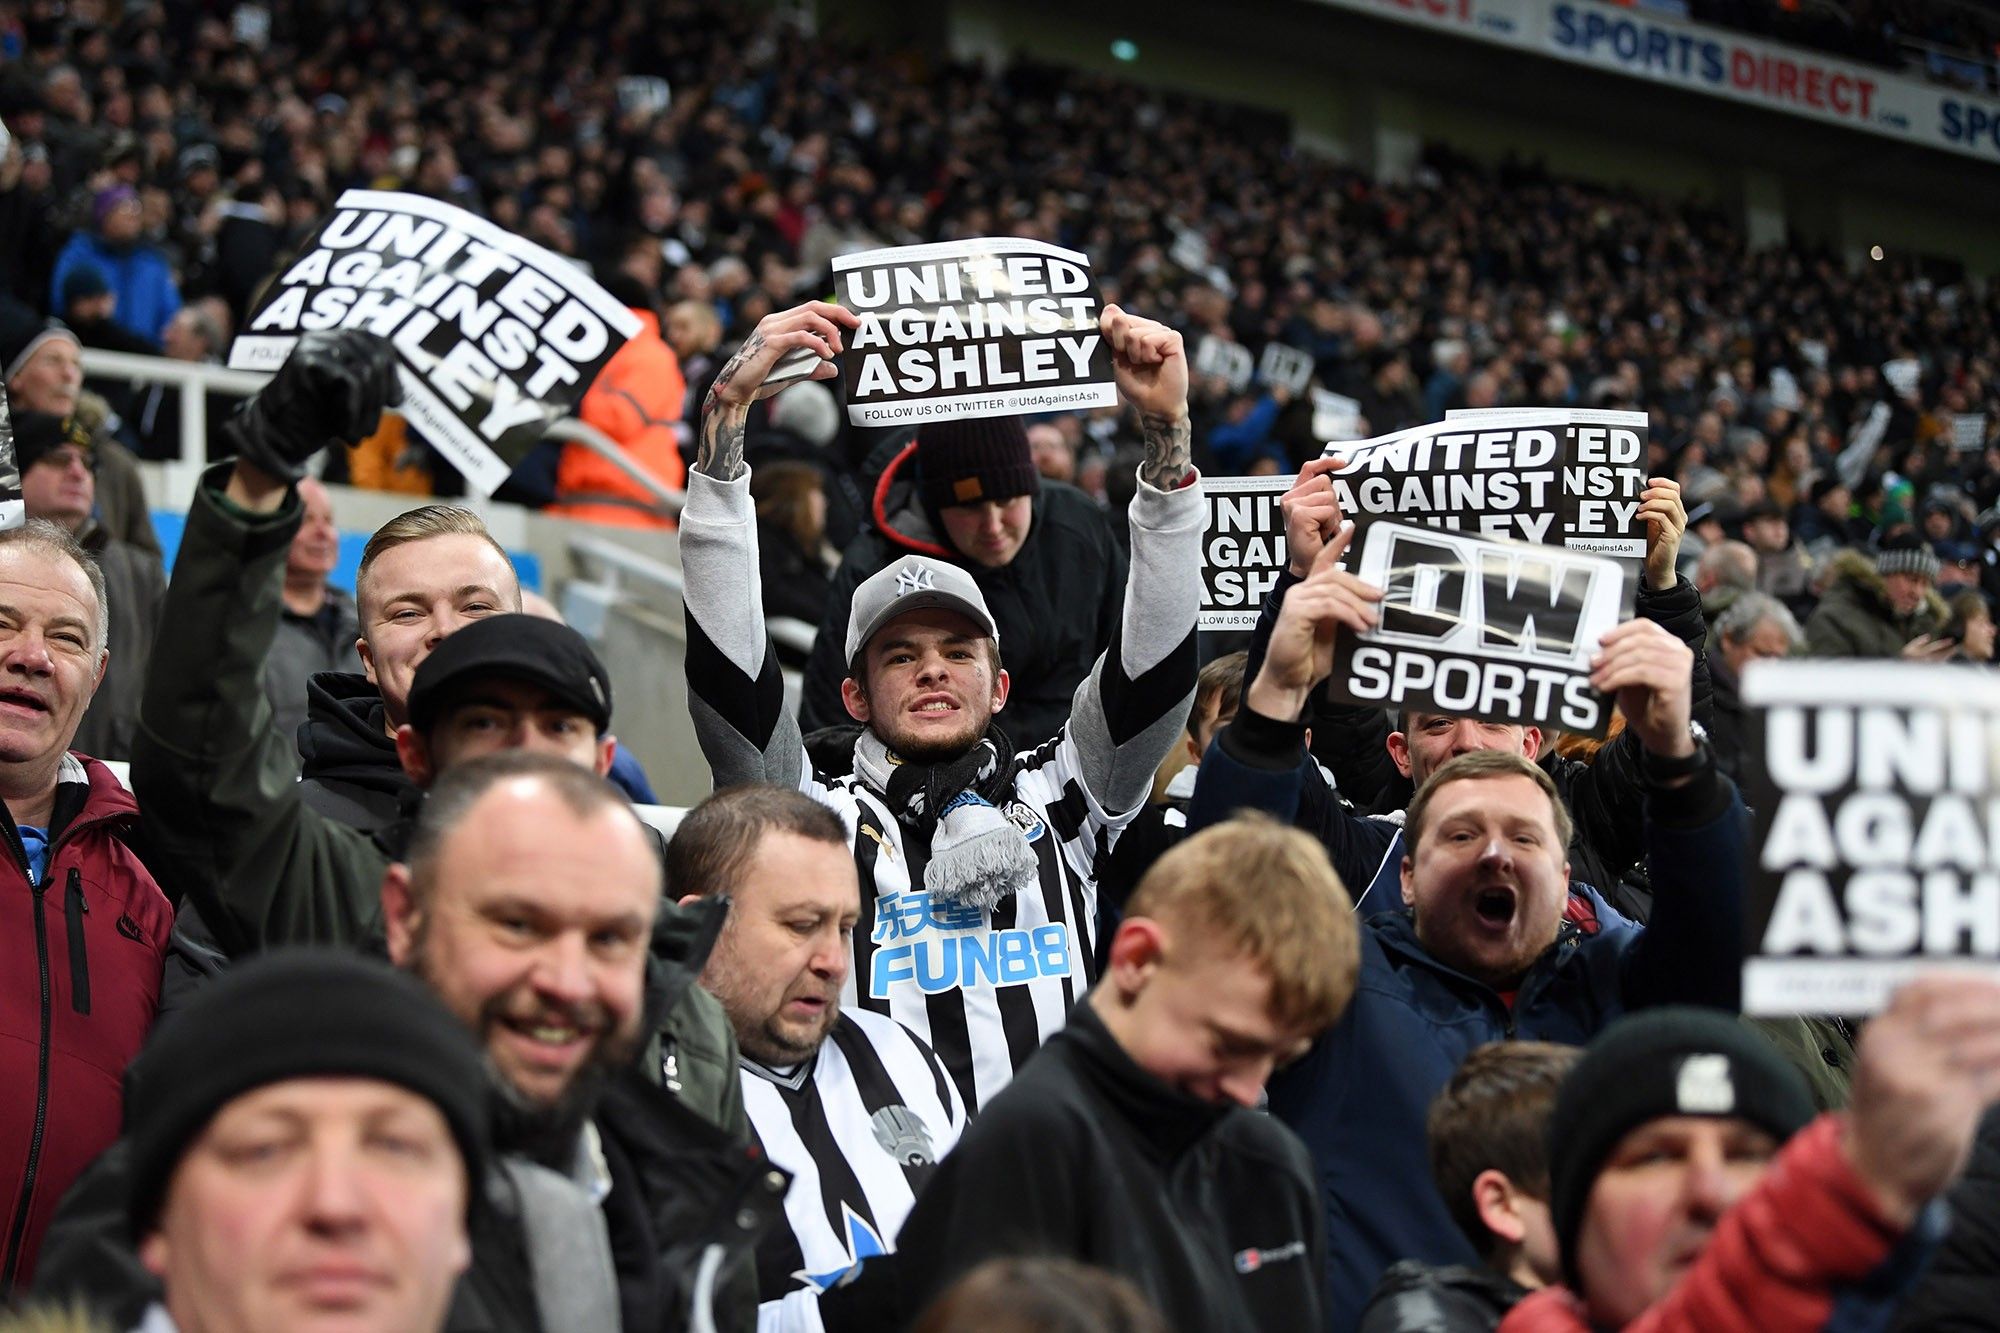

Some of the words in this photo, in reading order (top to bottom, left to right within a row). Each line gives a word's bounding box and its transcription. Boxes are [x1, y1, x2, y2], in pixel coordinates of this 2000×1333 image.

[318, 209, 609, 363] UNITED
[846, 257, 1090, 308] UNITED
[281, 249, 580, 399] AGAINST
[851, 297, 1096, 350] AGAINST
[251, 286, 544, 442] ASHLEY
[855, 335, 1100, 397] ASHLEY
[864, 408, 913, 420] FOLLOW
[916, 406, 932, 416] US
[935, 404, 952, 414] ON
[956, 399, 1005, 412] TWITTER
[1008, 392, 1100, 408] @UtdAgainstAsh
[1566, 427, 1641, 464] ED
[1332, 471, 1555, 514] AGAINST
[1227, 616, 1240, 625] US
[1242, 616, 1256, 625] ON
[1348, 647, 1600, 731] SPORTS
[873, 925, 1070, 997] FUN88
